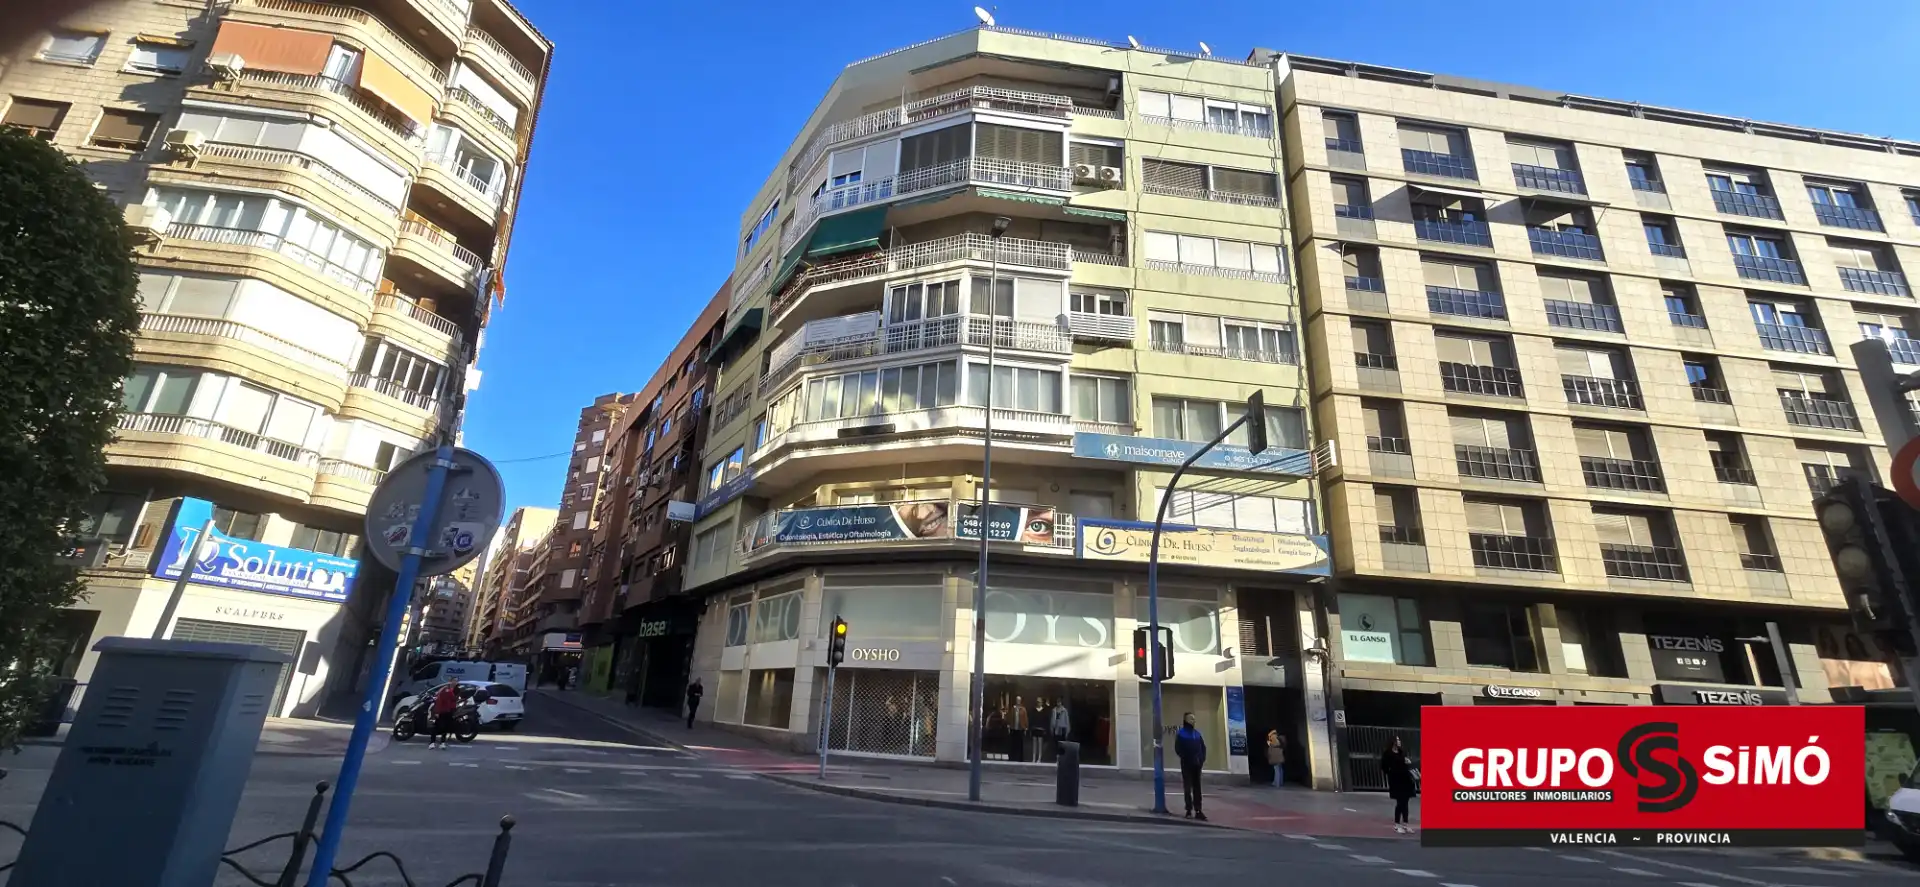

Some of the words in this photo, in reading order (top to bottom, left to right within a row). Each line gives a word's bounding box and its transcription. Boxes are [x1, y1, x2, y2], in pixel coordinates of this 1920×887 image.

[1124, 444, 1185, 458] maisonnave
[853, 516, 876, 526] HUESO
[1183, 540, 1212, 552] HUESO
[215, 606, 284, 620] SCALPERS
[638, 617, 667, 637] base
[1349, 634, 1358, 642] EL
[1360, 635, 1386, 643] GANSO
[852, 648, 900, 661] OYSHO
[1501, 687, 1511, 695] EL
[1512, 688, 1540, 697] GANSO
